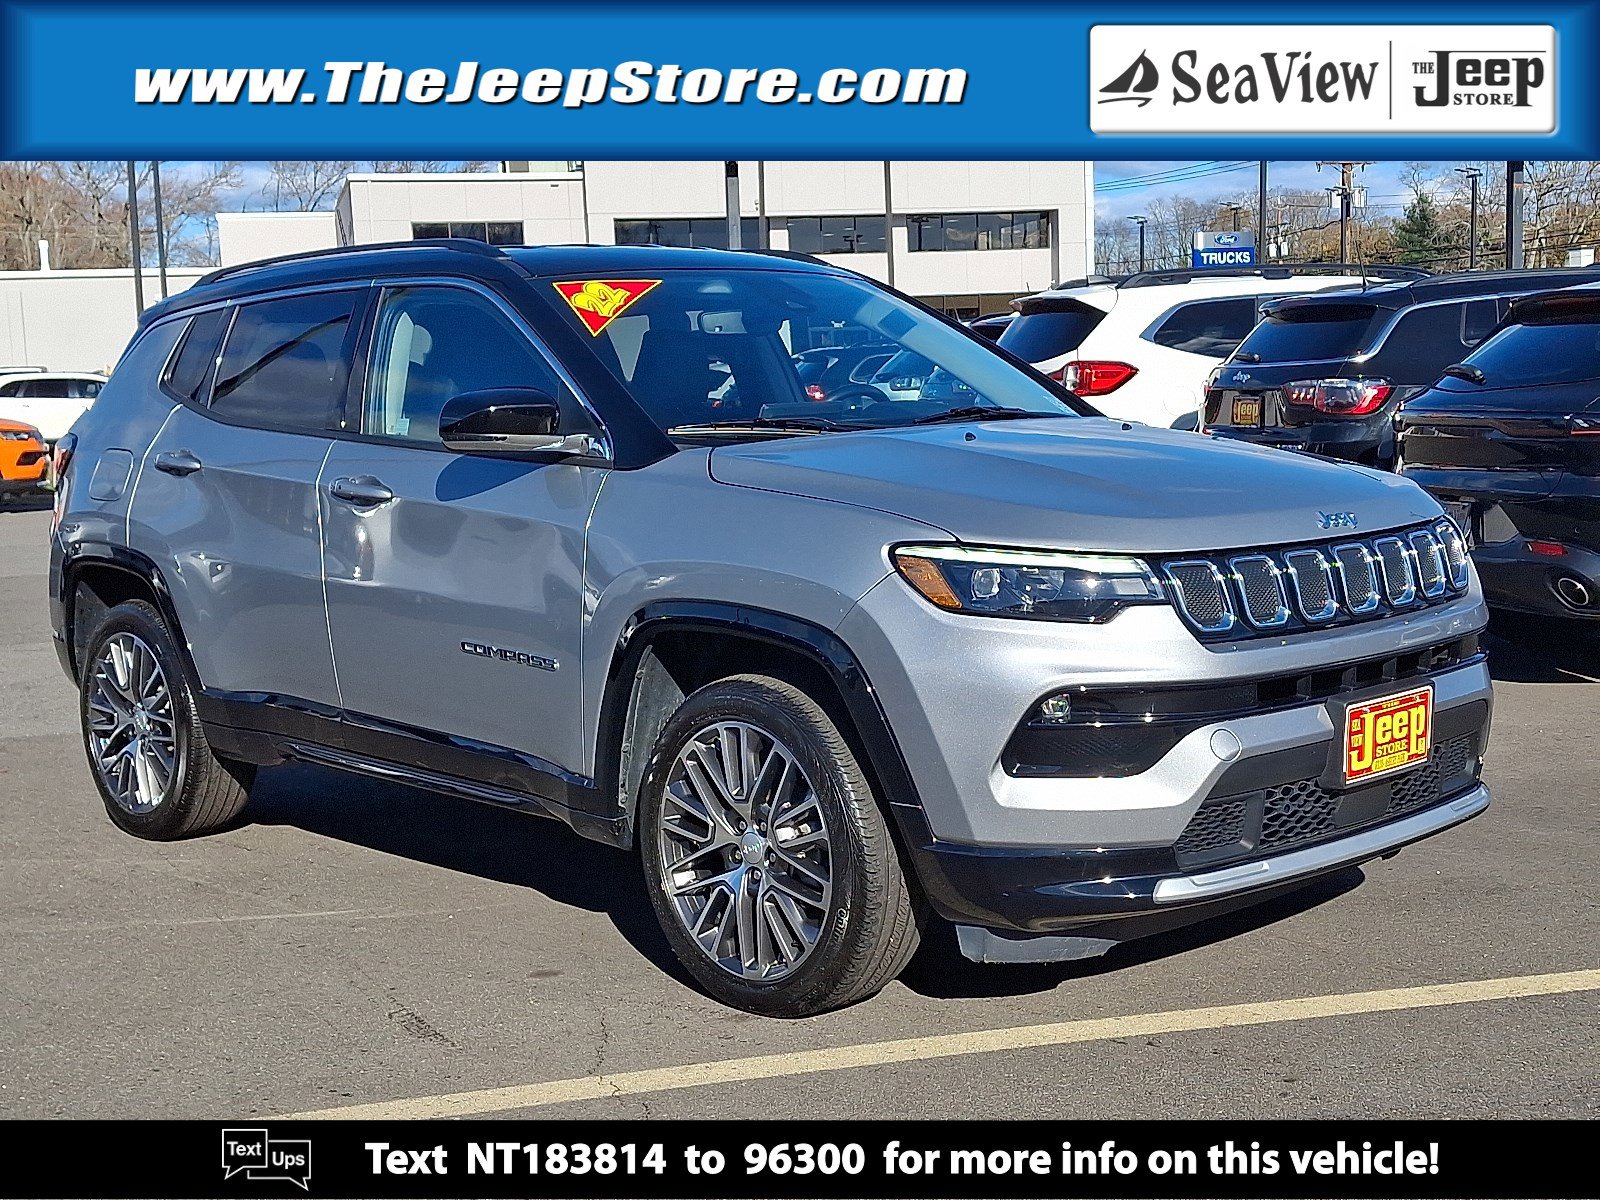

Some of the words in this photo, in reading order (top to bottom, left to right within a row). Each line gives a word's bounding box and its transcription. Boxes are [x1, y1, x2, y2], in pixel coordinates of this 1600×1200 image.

[1201, 252, 1251, 265] TRUCKS
[571, 281, 631, 317] 22
[1233, 401, 1259, 424] Jeep
[1315, 510, 1358, 529] Jeep
[460, 641, 560, 672] COMPASS
[1349, 704, 1426, 772] Jeep
[1376, 739, 1408, 758] STORE
